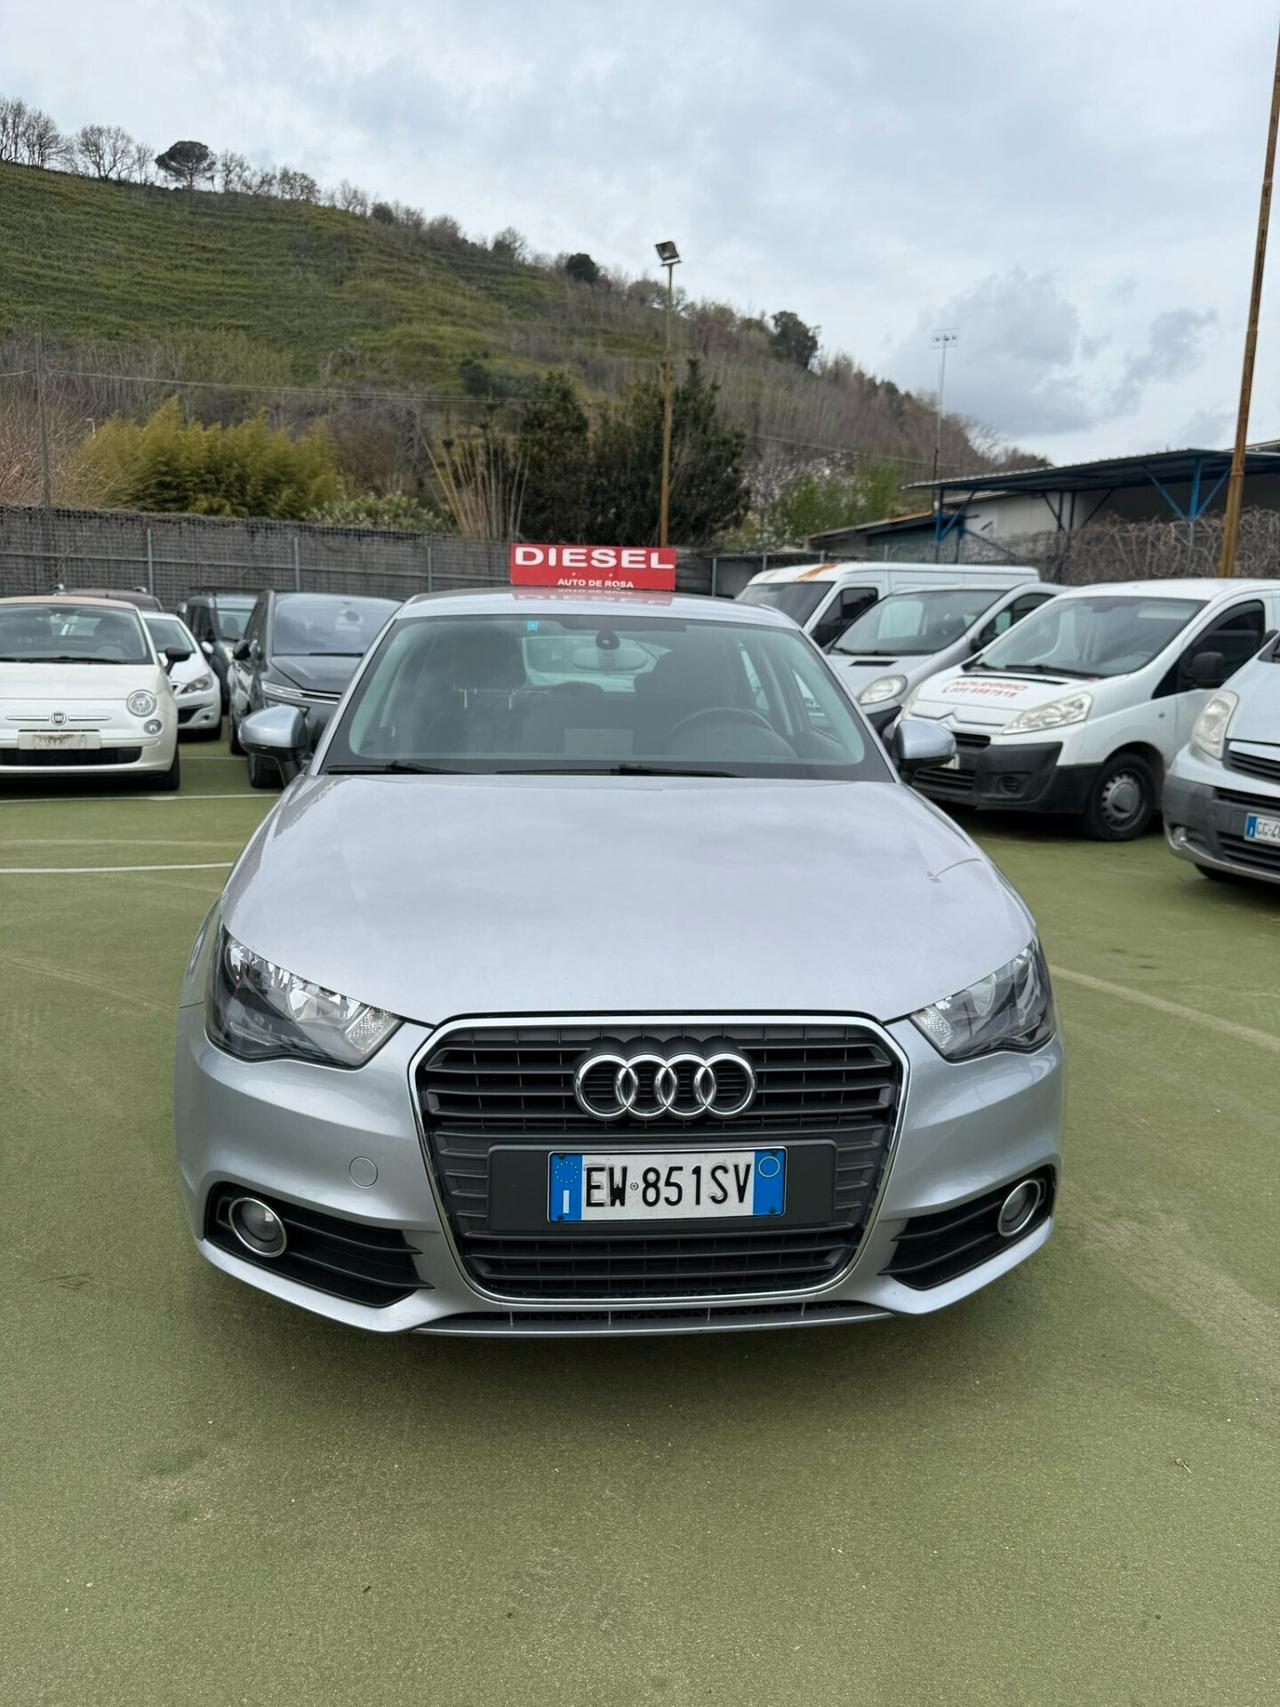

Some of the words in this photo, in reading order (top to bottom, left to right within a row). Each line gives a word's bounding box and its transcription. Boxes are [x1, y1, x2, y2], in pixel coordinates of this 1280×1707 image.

[515, 547, 674, 569] DIESEL
[557, 578, 586, 587] AUTO
[588, 579, 602, 587] DE
[604, 580, 634, 588] ROSA
